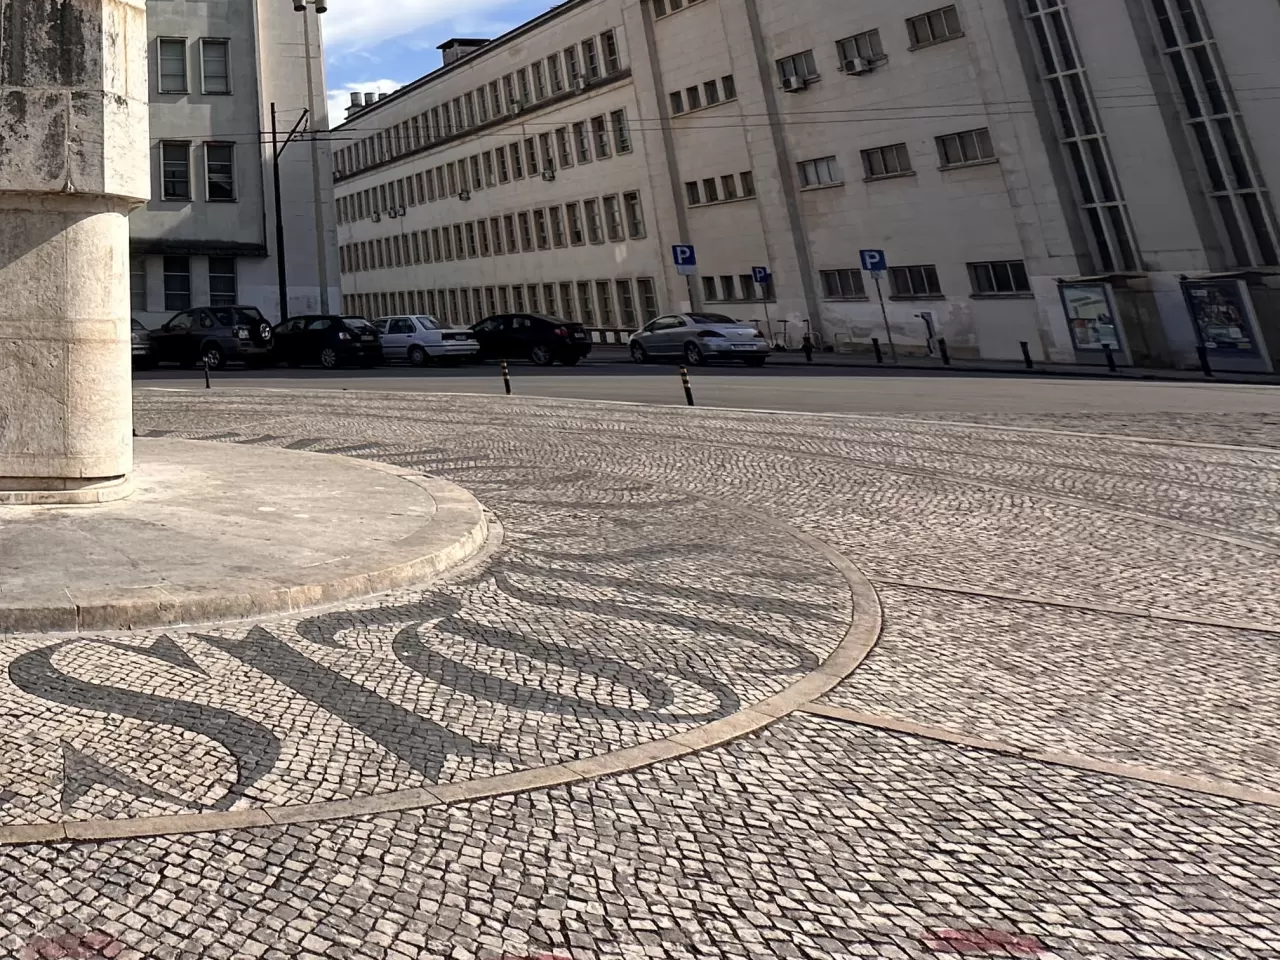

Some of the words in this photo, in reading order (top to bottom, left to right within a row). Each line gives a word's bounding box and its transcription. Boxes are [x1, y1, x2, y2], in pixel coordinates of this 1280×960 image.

[676, 246, 690, 264] P
[864, 251, 880, 269] P
[755, 268, 765, 281] P
